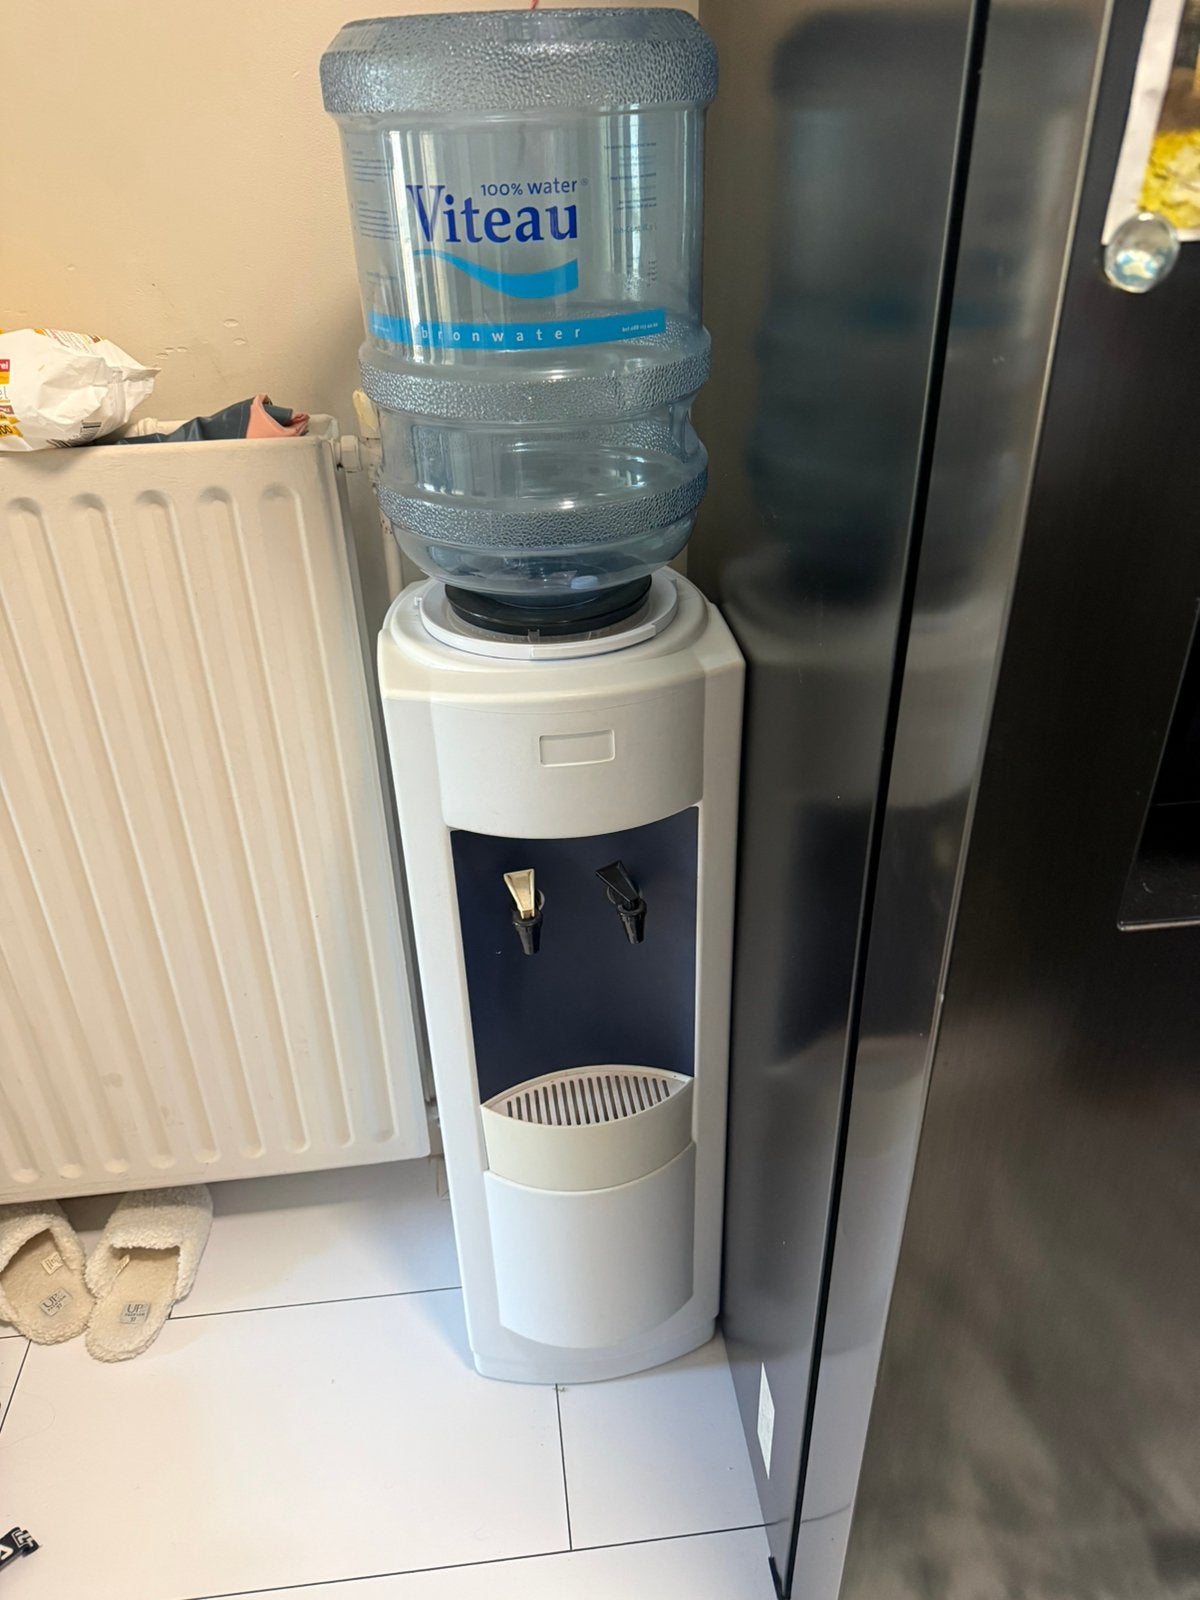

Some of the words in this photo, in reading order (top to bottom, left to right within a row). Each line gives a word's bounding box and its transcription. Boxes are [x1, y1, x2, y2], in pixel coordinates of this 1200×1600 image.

[481, 183, 523, 196] 100%
[527, 177, 578, 195] water
[406, 184, 578, 244] Viteau
[421, 326, 581, 343] bronwater
